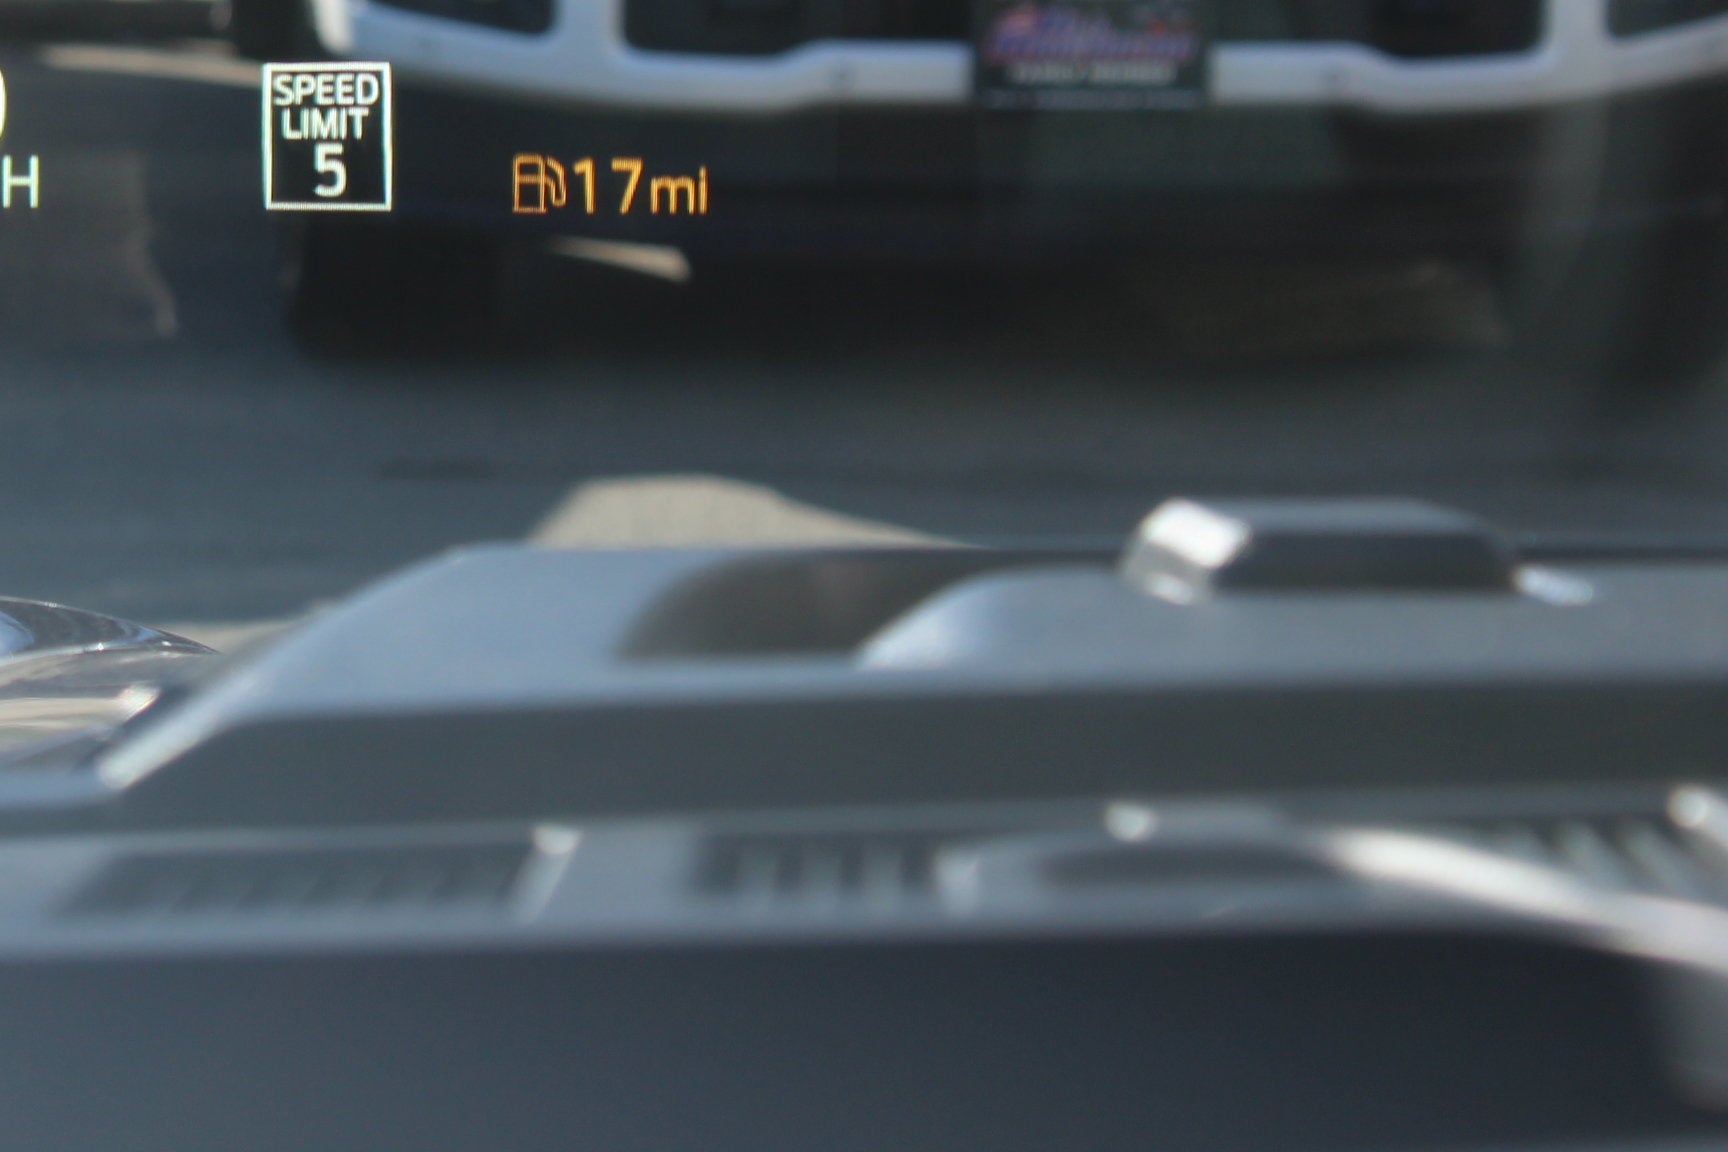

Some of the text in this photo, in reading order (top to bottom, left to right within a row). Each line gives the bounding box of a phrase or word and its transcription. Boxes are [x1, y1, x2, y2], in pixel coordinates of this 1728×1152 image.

[273, 72, 380, 106] SPEED
[281, 107, 370, 141] LIMIT
[313, 143, 348, 199] 5
